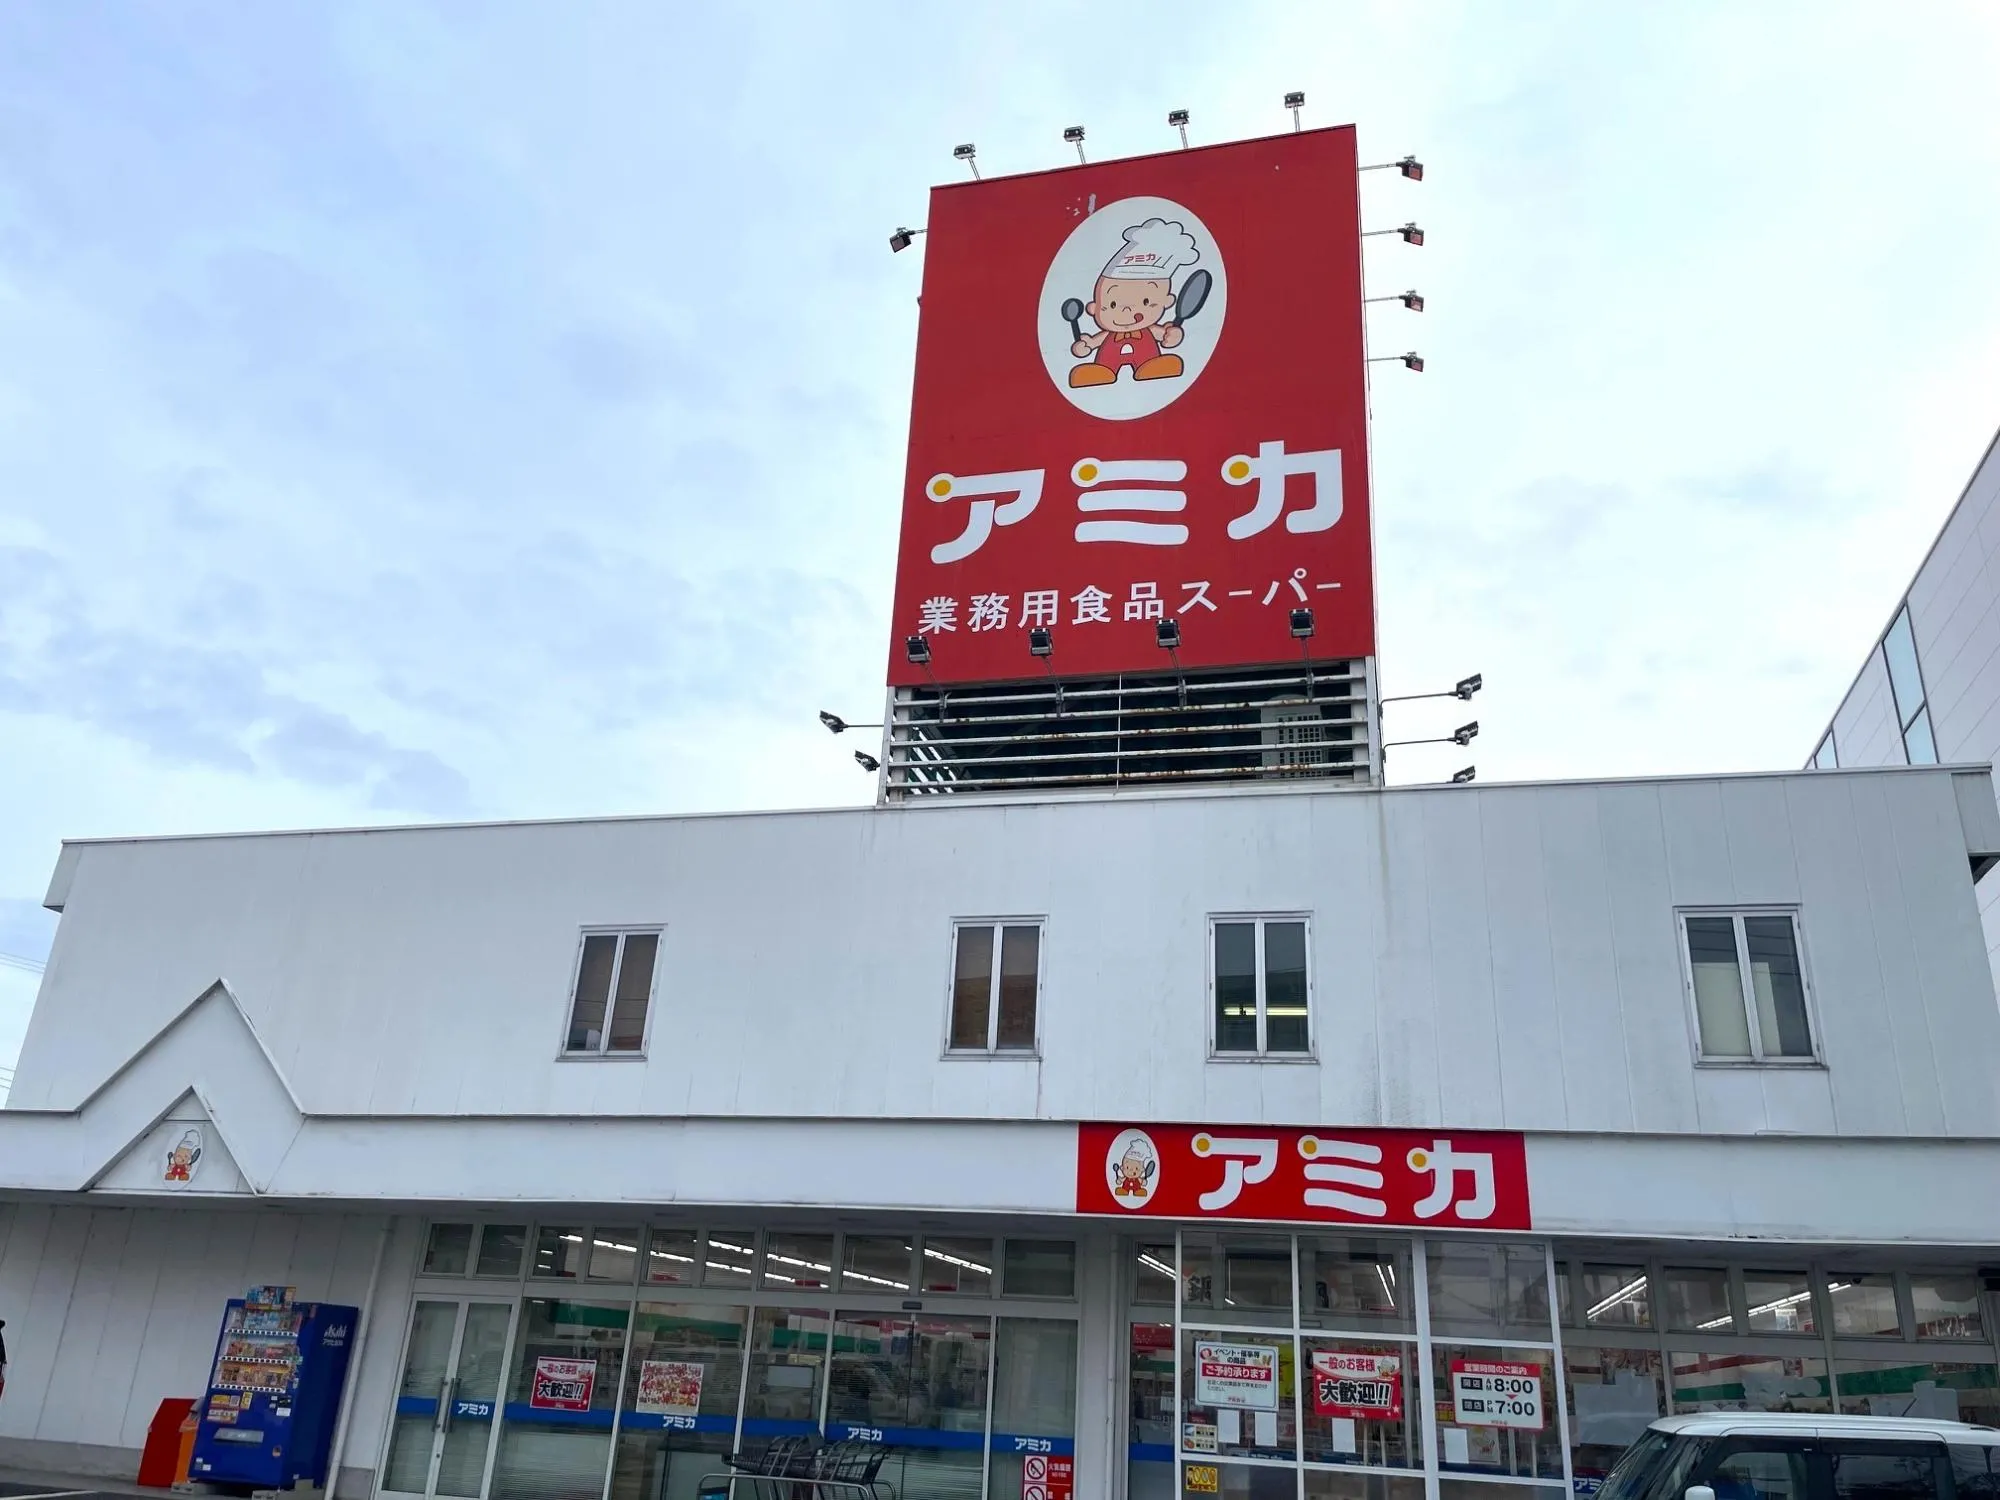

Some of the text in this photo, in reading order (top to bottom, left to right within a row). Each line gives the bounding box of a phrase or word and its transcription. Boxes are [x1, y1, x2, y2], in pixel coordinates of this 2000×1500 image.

[1124, 253, 1156, 264] アミカ
[926, 440, 1344, 564] アミカ
[918, 567, 1341, 634] 業務用食品スーパー
[1191, 1132, 1496, 1220] アミカ
[1319, 1356, 1376, 1372] 一般のお客様
[1494, 1378, 1533, 1394] 8:00
[458, 1402, 488, 1415] アミカ
[1495, 1400, 1535, 1416] 7:00
[663, 1415, 695, 1429] アミカ
[848, 1427, 882, 1441] アミカ
[1015, 1437, 1052, 1452] アミカ
[1573, 1476, 1602, 1491] アミ
